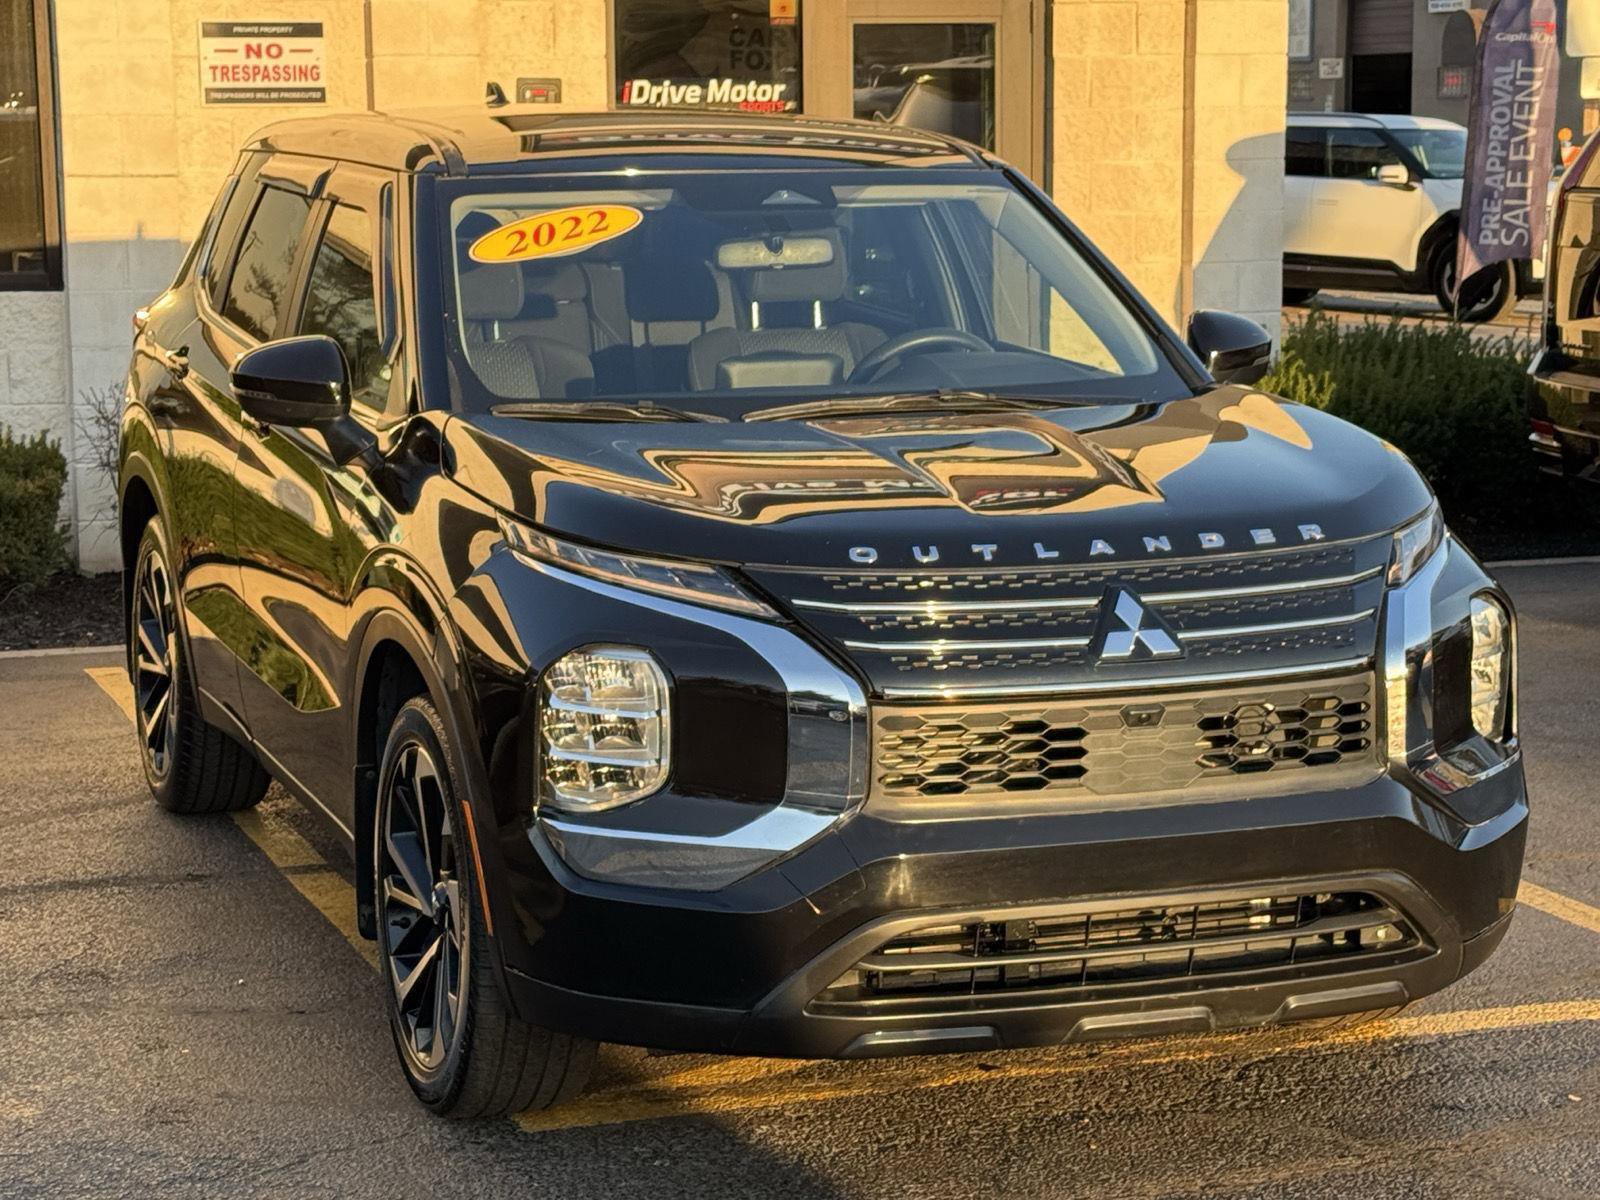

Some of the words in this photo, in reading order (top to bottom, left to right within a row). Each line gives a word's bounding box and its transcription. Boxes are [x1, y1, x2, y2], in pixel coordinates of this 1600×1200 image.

[244, 43, 283, 59] NO
[209, 65, 321, 82] TRESPASSING
[622, 79, 701, 105] iDrive
[707, 78, 787, 103] Motor
[1508, 58, 1545, 162] EVENT
[1478, 58, 1517, 246] PRE-APPROVAL
[1500, 169, 1534, 247] SALE
[506, 210, 609, 257] 2022
[848, 523, 1327, 564] OUTLANDER
